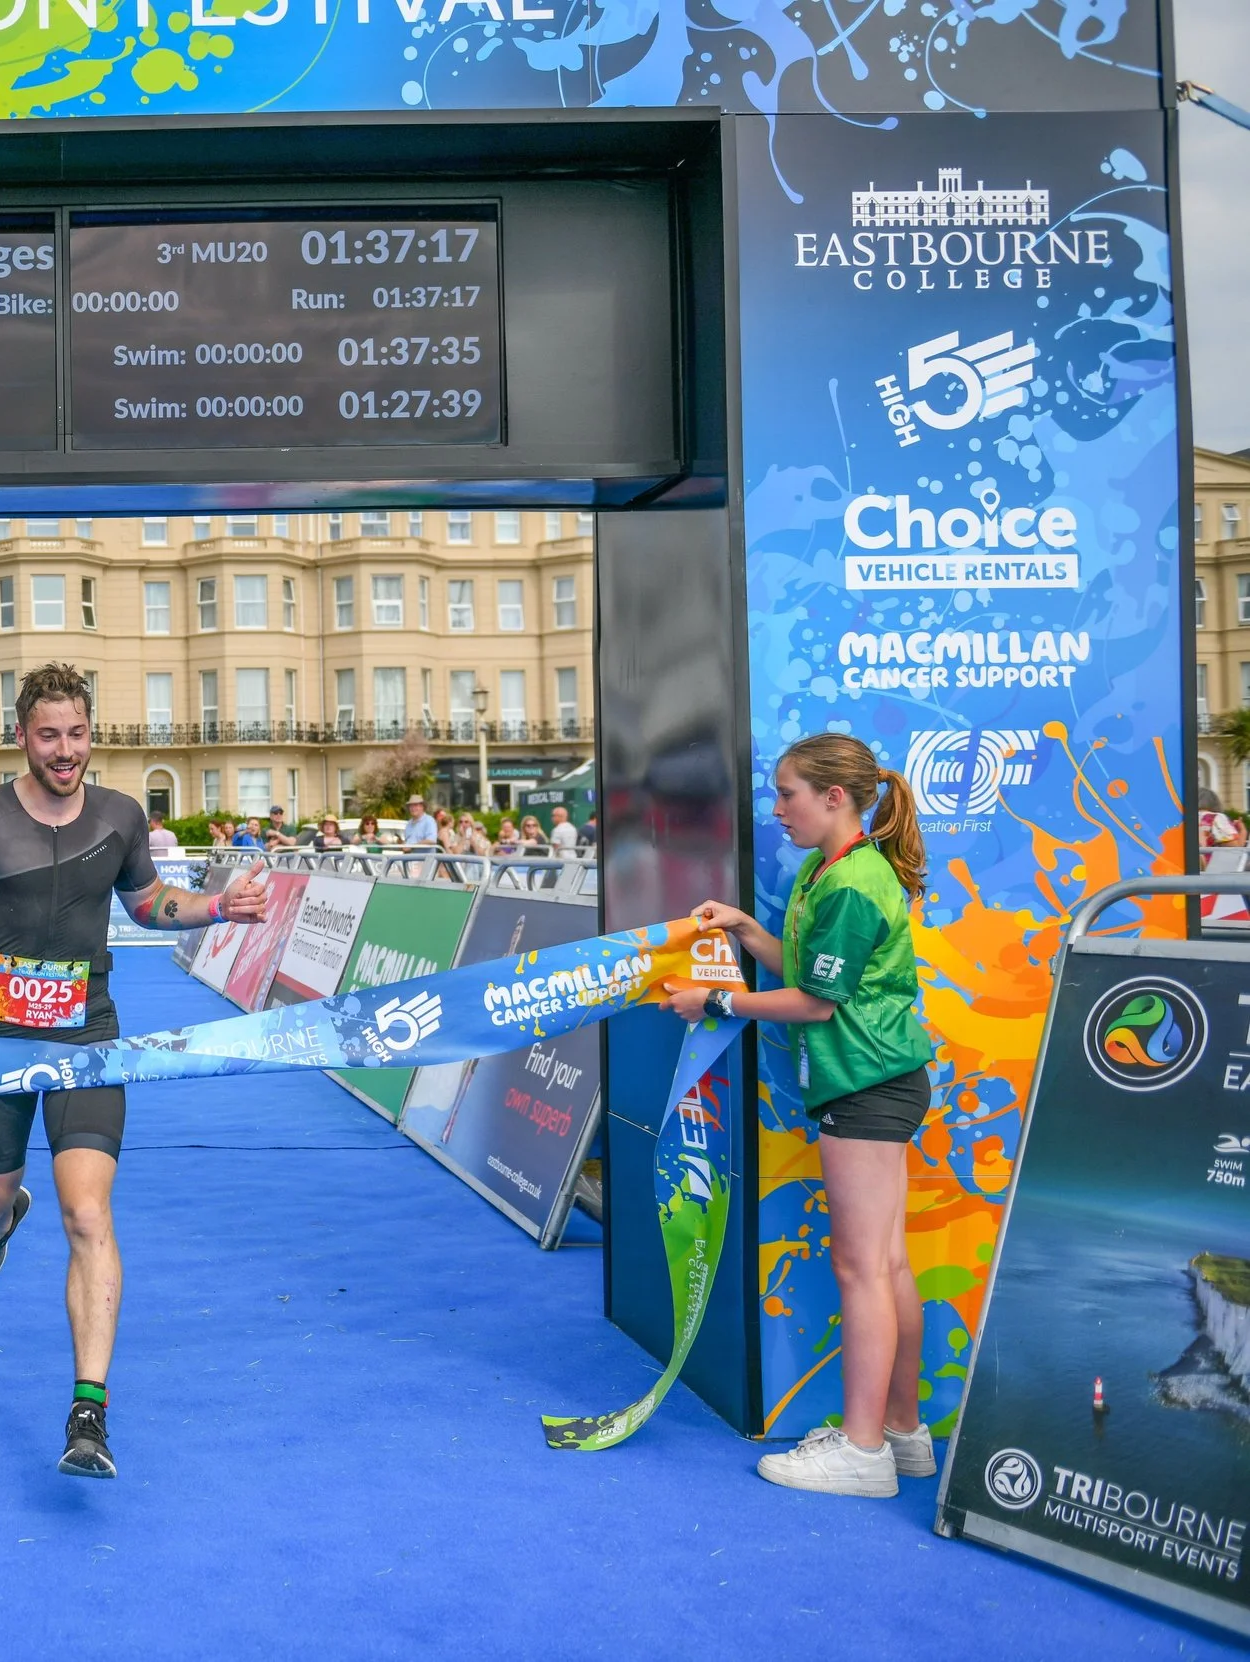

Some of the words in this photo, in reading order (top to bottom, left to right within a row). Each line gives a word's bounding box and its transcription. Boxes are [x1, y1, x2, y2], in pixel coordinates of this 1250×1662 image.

[156, 243, 185, 264] 3rd
[192, 242, 268, 263] MU20
[301, 229, 479, 265] 01:37:17
[794, 230, 1111, 267] EASTBOURNE
[853, 269, 1051, 290] COLLEGE
[72, 291, 179, 312] 00:00:00
[292, 288, 345, 309] Run:
[373, 286, 480, 308] 01:37:17
[113, 345, 186, 366] Swim:
[195, 343, 303, 365] 00:00:00
[338, 337, 481, 366] 01:37:35
[114, 398, 186, 419] Swim:
[196, 396, 303, 418] 00:00:00
[339, 390, 482, 420] 01:27:39
[875, 374, 920, 447] HIGH
[844, 488, 1077, 549] Choice
[857, 563, 957, 581] VEHICLE
[965, 562, 1067, 580] RENTALS
[838, 631, 1090, 665] MACMILLAN
[843, 667, 949, 688] CANCER
[955, 665, 1076, 687] SUPPORT
[918, 820, 961, 833] cation
[963, 819, 992, 832] First
[160, 865, 188, 873] HOVE
[690, 937, 736, 963] Ch
[18, 961, 68, 972] EASTOURNE
[696, 968, 742, 978] VEHICLE
[9, 976, 73, 1003] 0025
[483, 954, 652, 1012] MACMILLAN
[28, 1002, 52, 1010] M25-29
[491, 999, 563, 1026] CANCER
[566, 976, 644, 1009] SUPPORT
[26, 1010, 53, 1019] RYAN
[361, 1026, 393, 1063] HIGH
[524, 1041, 556, 1078] Find
[546, 1060, 582, 1090] your
[504, 1087, 532, 1116] own
[529, 1099, 573, 1137] superb
[487, 1155, 542, 1200] eastbourne-college.co.uk
[1214, 1159, 1243, 1171] SWIM
[1206, 1169, 1245, 1188] 750m
[1053, 1465, 1247, 1553] TRIBOURNE
[1044, 1501, 1159, 1553] MULTISPORT
[1162, 1540, 1240, 1581] EVENTS
